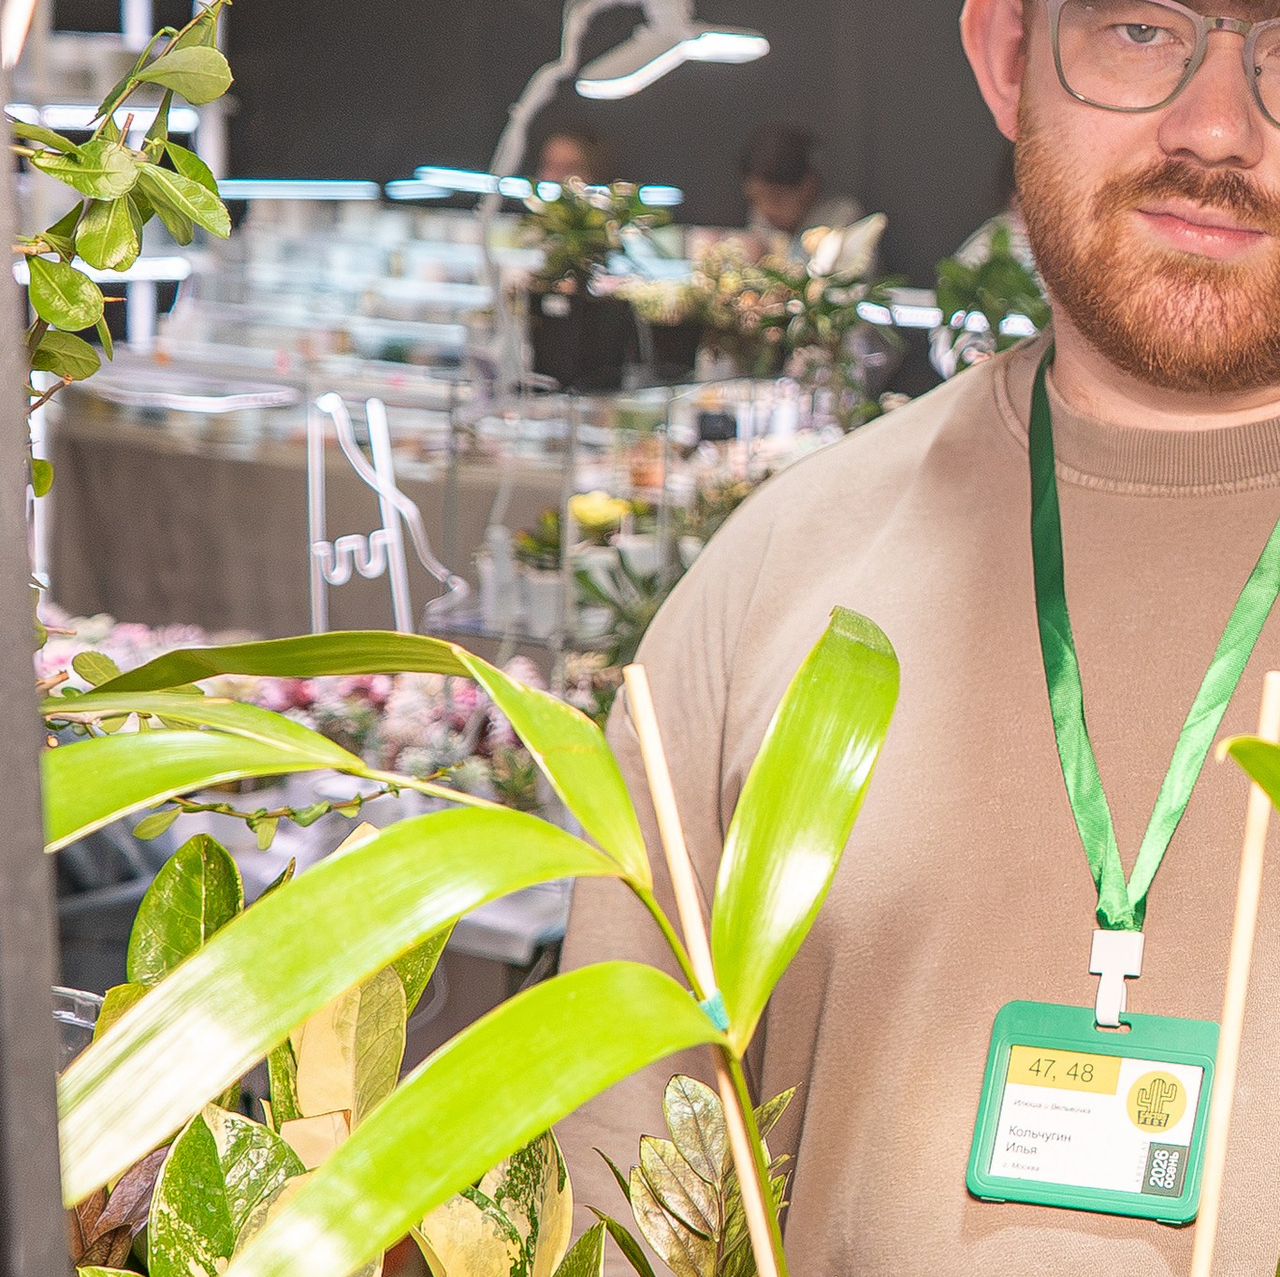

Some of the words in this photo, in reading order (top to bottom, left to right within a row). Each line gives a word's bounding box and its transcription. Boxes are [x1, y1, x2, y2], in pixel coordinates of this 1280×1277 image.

[1029, 1058, 1056, 1082] 47,
[1066, 1063, 1095, 1084] 48
[1008, 1125, 1072, 1143] Кольчугин
[1006, 1142, 1038, 1155] Илья
[1149, 1149, 1170, 1188] 2026
[1163, 1151, 1180, 1189] осень
